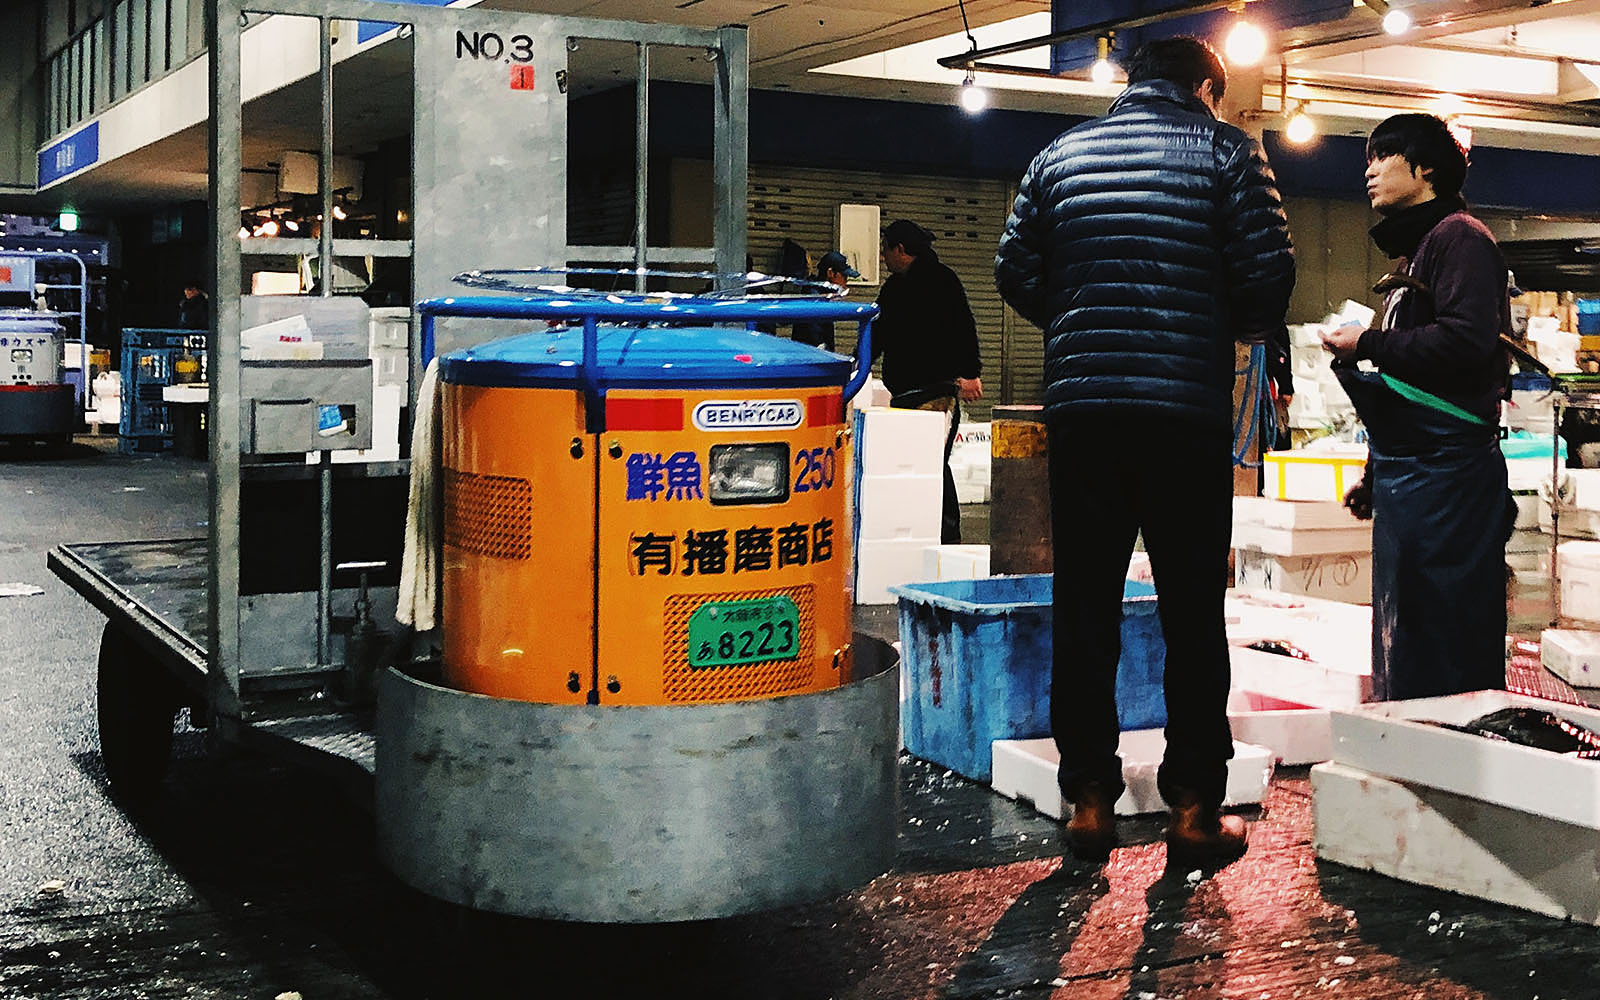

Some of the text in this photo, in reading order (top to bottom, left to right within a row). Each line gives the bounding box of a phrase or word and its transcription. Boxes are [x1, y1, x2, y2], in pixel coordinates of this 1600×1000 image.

[456, 30, 534, 64] NO.3
[706, 408, 797, 424] BENRYCAR
[626, 447, 835, 502] 鮮魚 250
[718, 619, 794, 660] 8223
